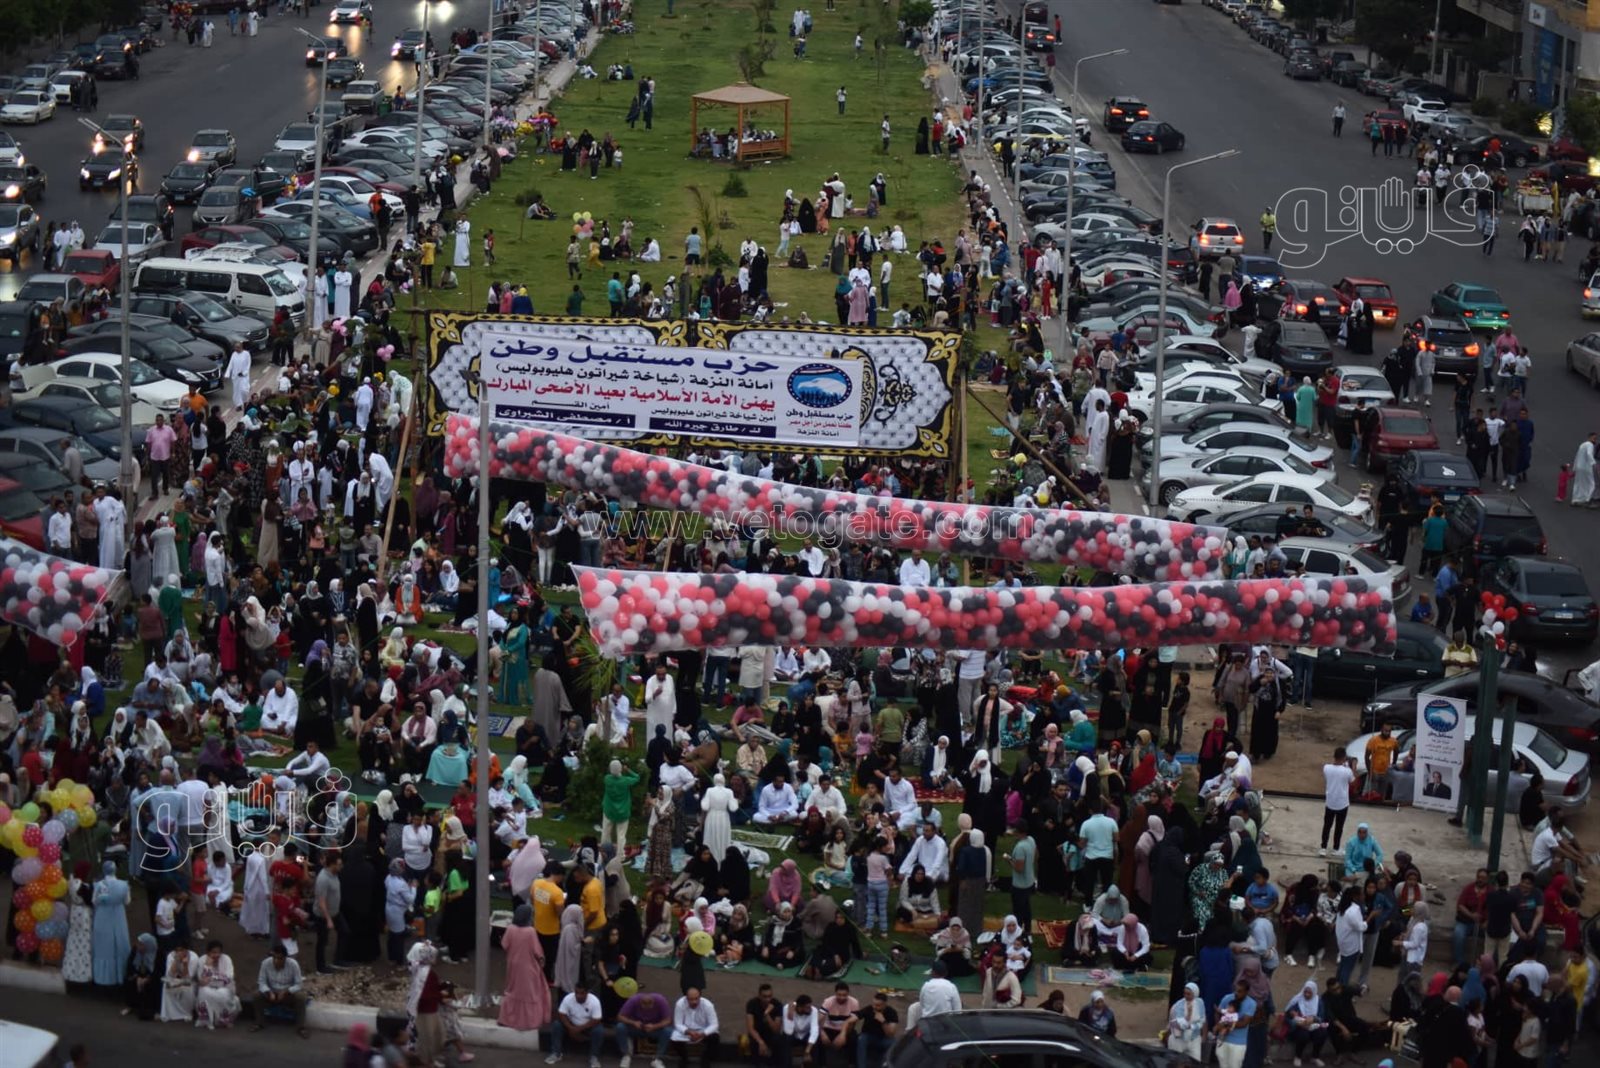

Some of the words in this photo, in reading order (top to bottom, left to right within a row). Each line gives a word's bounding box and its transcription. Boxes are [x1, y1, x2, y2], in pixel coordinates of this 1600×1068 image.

[490, 339, 559, 361] وطن
[568, 345, 695, 366] مستقبل
[703, 356, 779, 375] حزب
[577, 367, 630, 380] شيراتون
[689, 373, 734, 388] النزهة
[487, 378, 532, 393] المبارك
[593, 385, 627, 400] بعيد
[710, 423, 740, 433] طارق
